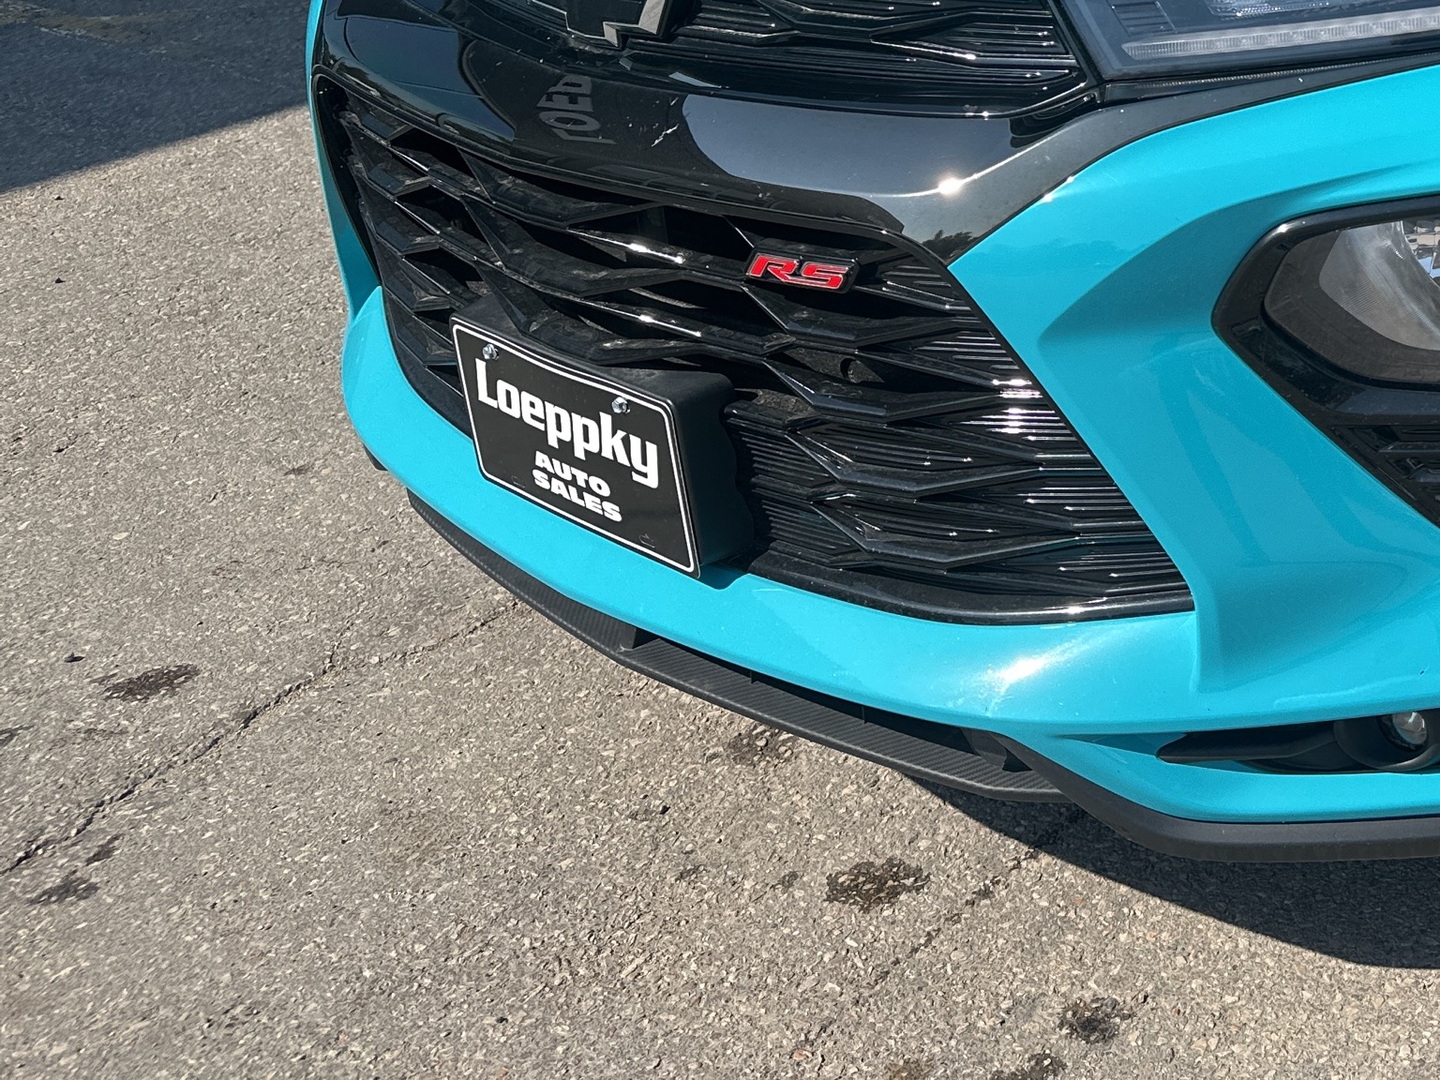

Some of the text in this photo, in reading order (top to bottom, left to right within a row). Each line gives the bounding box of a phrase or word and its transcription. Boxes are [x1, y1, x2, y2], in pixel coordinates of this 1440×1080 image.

[750, 253, 849, 290] RS
[475, 358, 659, 489] Loeppky
[532, 469, 622, 522] SALES
[535, 451, 611, 497] AUTO
